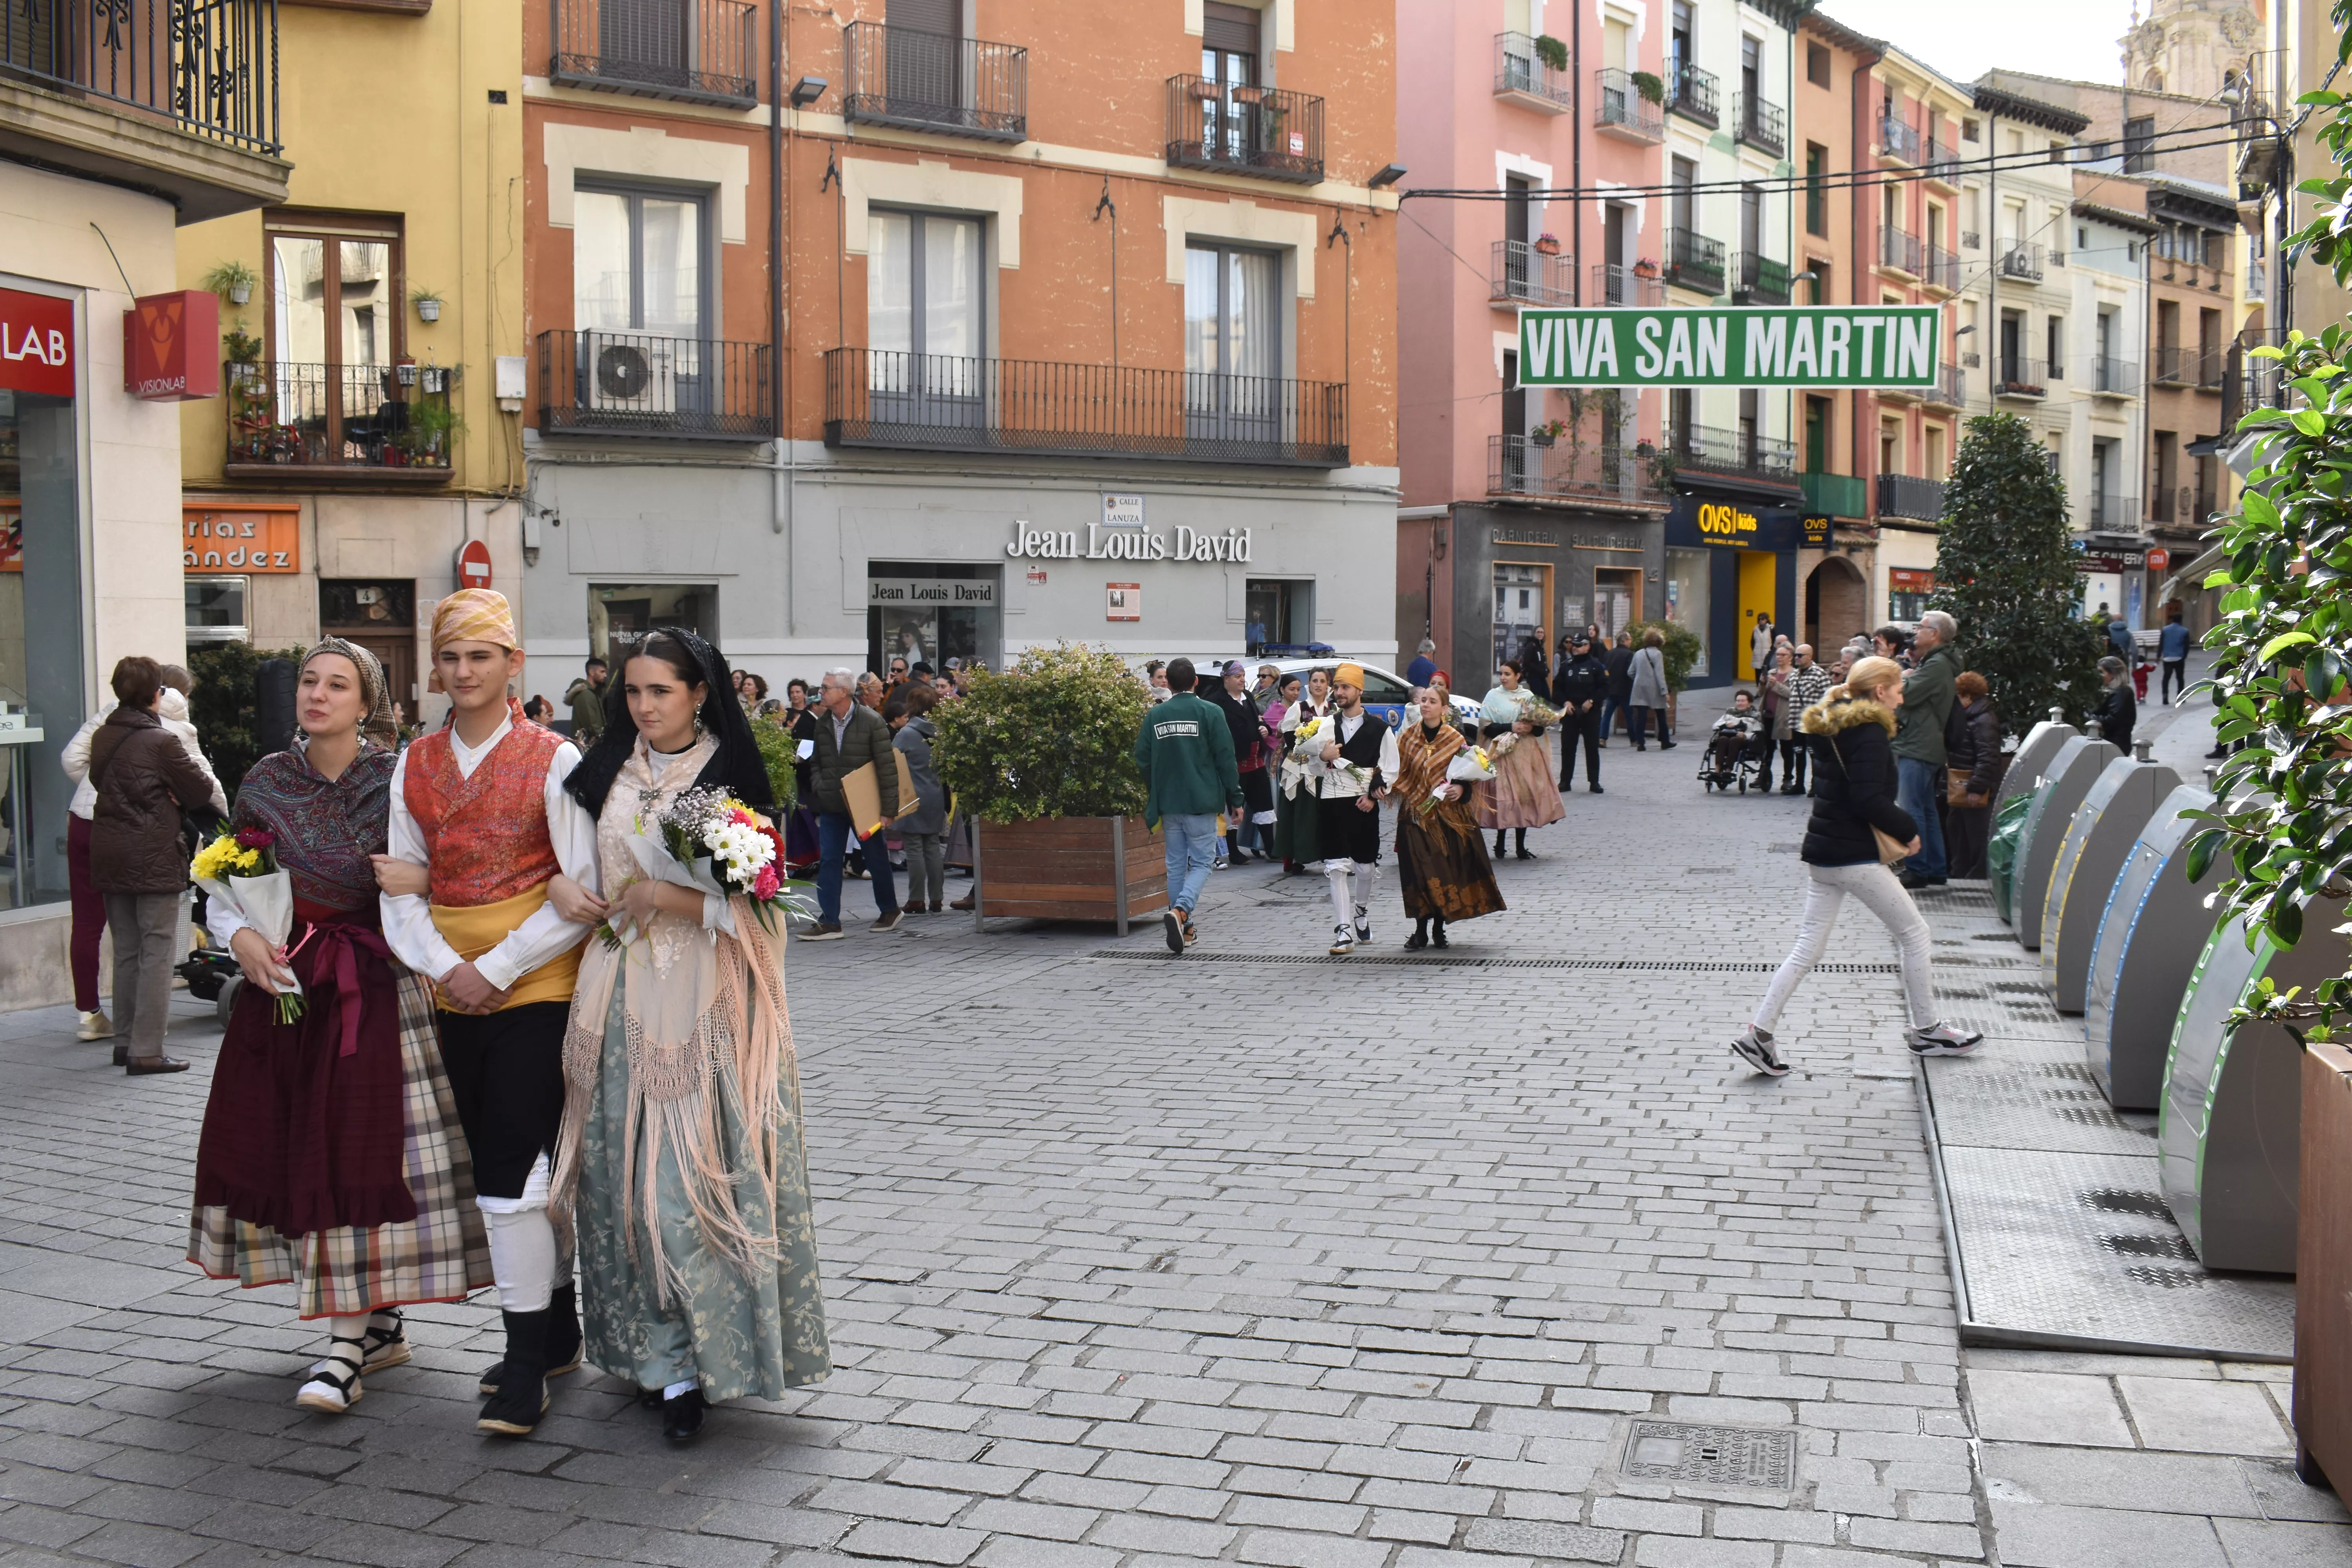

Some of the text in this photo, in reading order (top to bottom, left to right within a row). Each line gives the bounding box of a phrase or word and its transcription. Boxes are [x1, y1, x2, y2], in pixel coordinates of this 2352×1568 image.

[0, 322, 67, 366] LAB
[1525, 316, 1931, 378] VIVA SAN MARTIN
[139, 376, 185, 394] VISIONLAB
[1107, 514, 1140, 522] LANUZA
[1698, 503, 1757, 534] OVS kids
[1804, 518, 1828, 529] OVS
[1007, 520, 1252, 563] Jean Louis David
[363, 590, 370, 601] 4
[872, 583, 991, 601] Jean Louis David
[1167, 724, 1176, 733] SAN
[1177, 724, 1197, 733] MARTIN
